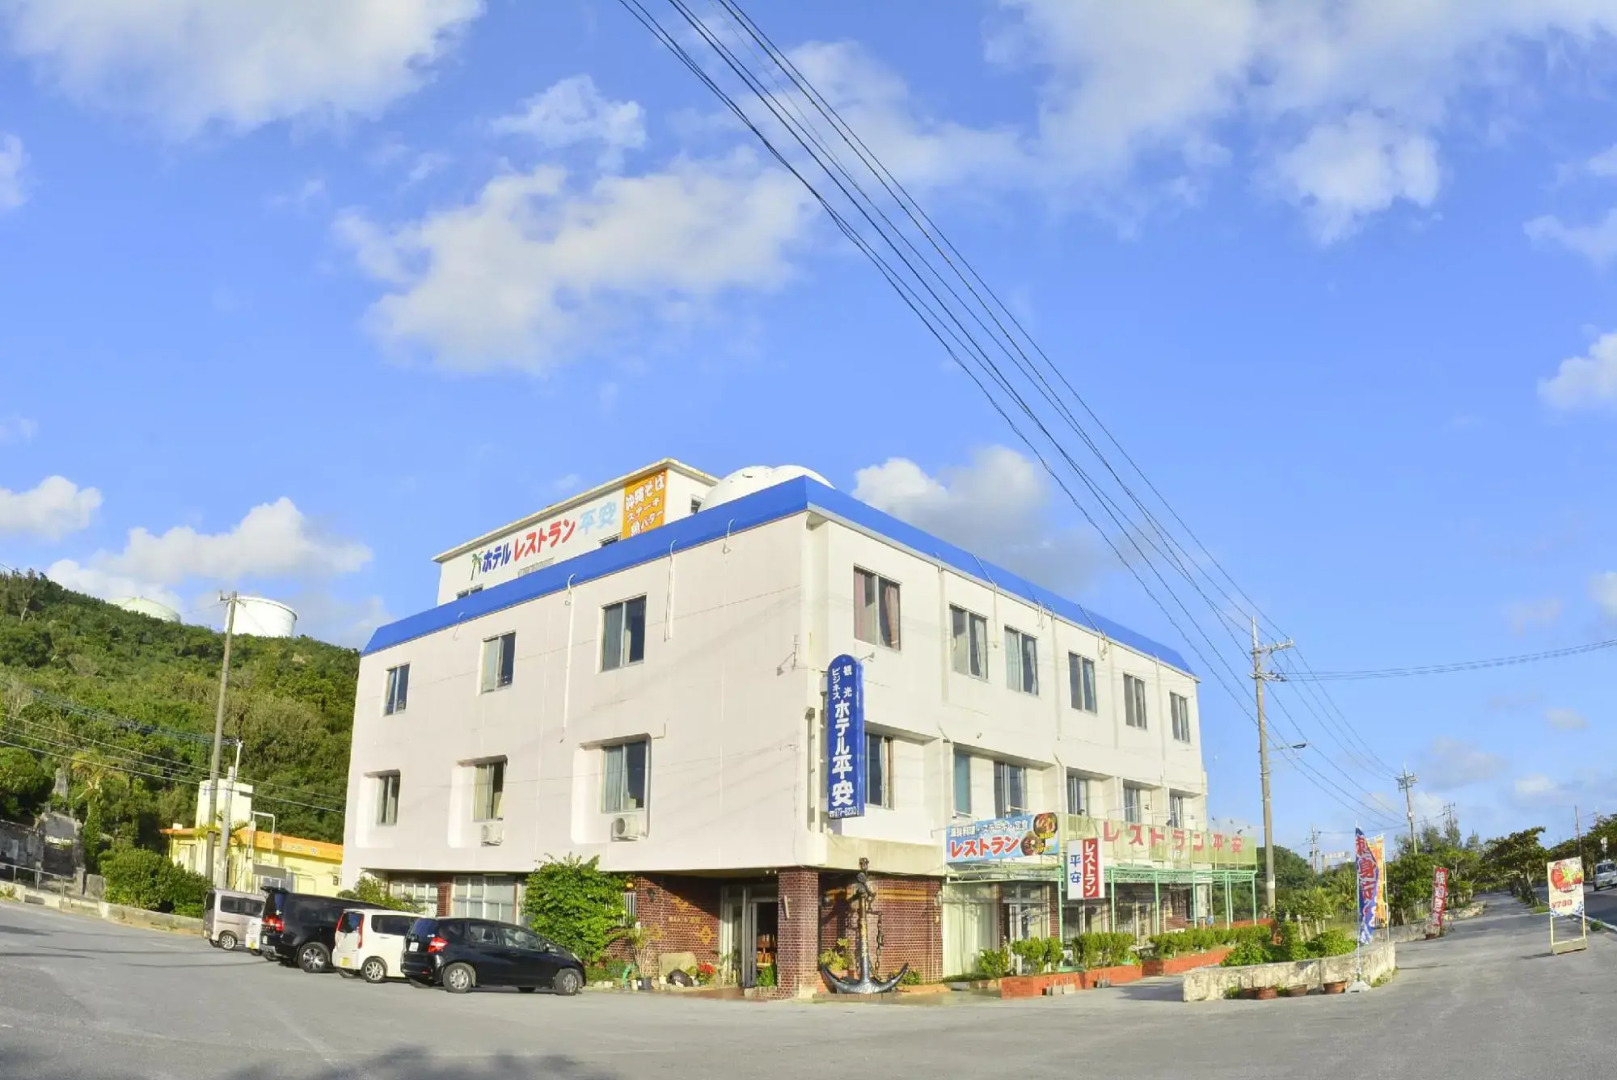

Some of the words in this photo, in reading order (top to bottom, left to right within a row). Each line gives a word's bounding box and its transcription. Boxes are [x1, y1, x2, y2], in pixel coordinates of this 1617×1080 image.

[627, 497, 660, 522] ステーキ
[483, 543, 511, 572] ホテル
[514, 519, 576, 561] レストラン
[579, 502, 616, 533] 平安
[832, 667, 841, 700] ビジネス
[832, 700, 853, 806] ホテル平安
[950, 835, 1021, 859] レストラン
[1070, 854, 1081, 884] 平安
[1085, 841, 1096, 896] レストラン
